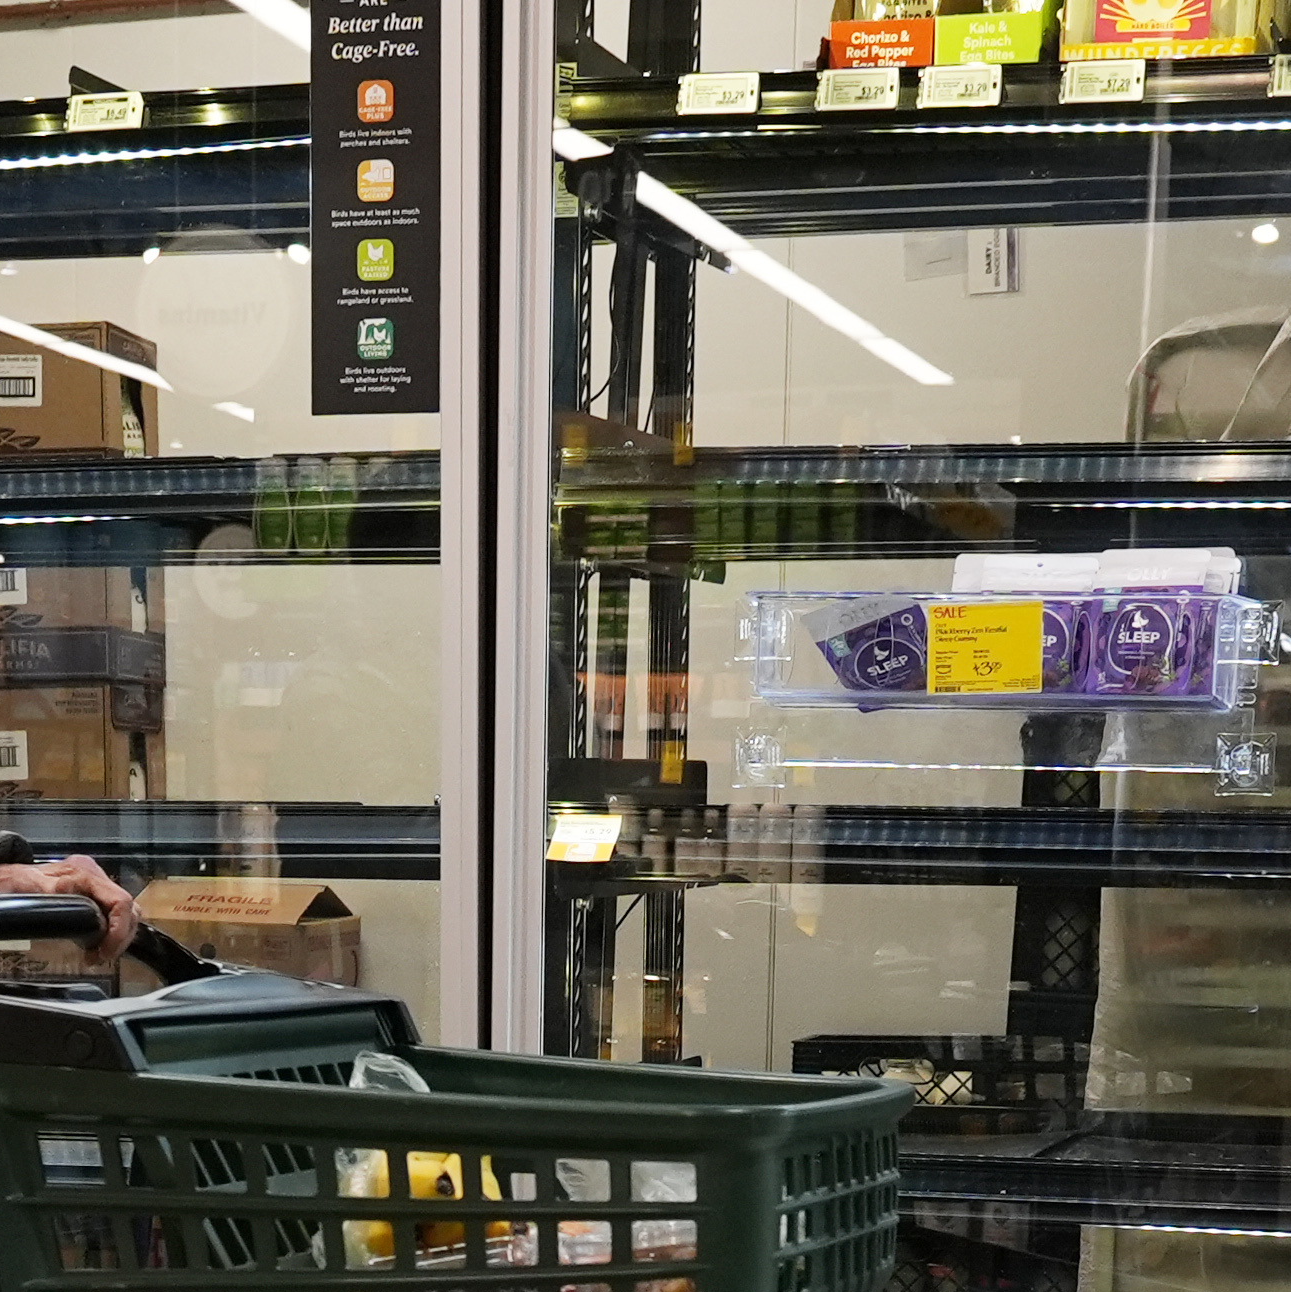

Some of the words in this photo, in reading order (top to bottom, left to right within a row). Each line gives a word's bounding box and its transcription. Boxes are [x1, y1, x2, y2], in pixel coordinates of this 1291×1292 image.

[328, 17, 380, 34] Better
[383, 12, 423, 31] than
[970, 22, 995, 33] Kale
[999, 21, 1007, 32] &
[851, 32, 898, 44] Chorizo
[900, 31, 910, 42] &
[963, 35, 1011, 49] Spinach
[331, 40, 420, 63] Cage-Free.
[846, 46, 869, 58] Red
[872, 45, 914, 59] Pepper
[985, 50, 1015, 61] Bites
[1127, 566, 1171, 581] OLLY
[933, 606, 967, 619] SALE
[1117, 632, 1160, 644] SLEEP
[867, 655, 908, 676] SLEEP
[187, 894, 273, 906] FRAGILE
[173, 905, 211, 913] HANDLE
[216, 907, 241, 915] WITH
